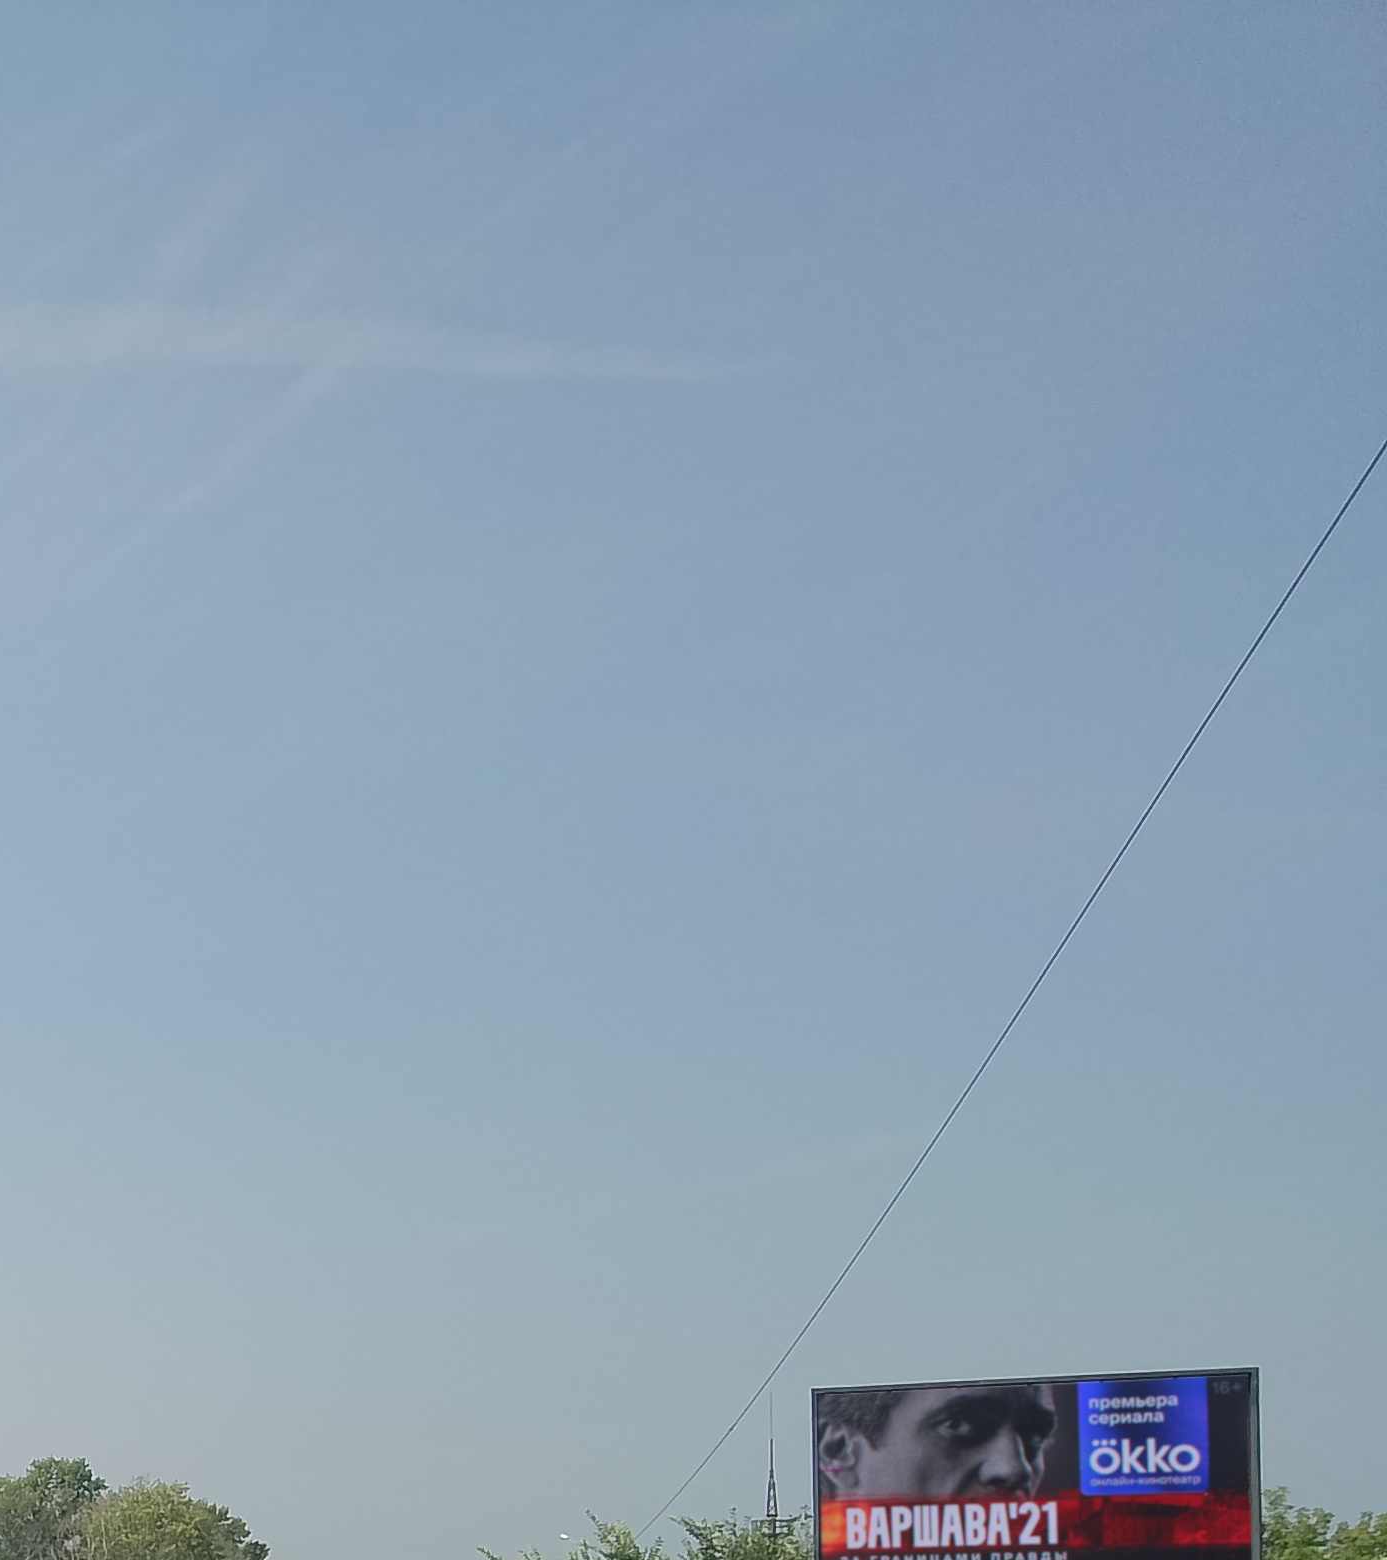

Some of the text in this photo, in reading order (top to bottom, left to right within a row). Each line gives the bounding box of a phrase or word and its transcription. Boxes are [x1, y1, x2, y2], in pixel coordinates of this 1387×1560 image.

[1088, 1395, 1180, 1411] премьера
[1088, 1411, 1165, 1427] сериала
[846, 1501, 1059, 1549] ВАРШАВА'21
